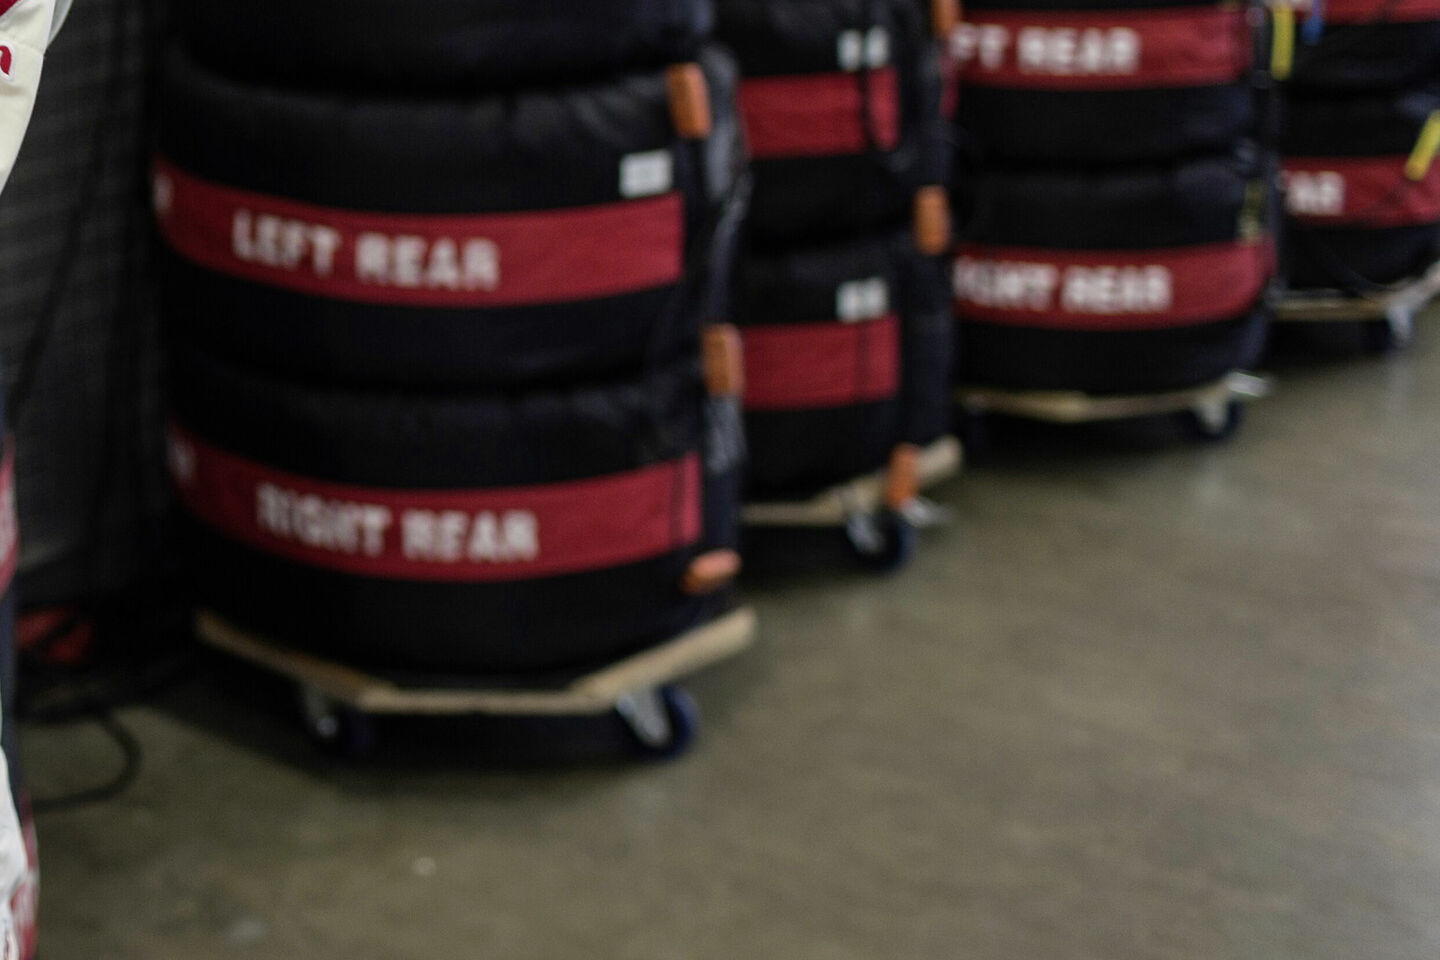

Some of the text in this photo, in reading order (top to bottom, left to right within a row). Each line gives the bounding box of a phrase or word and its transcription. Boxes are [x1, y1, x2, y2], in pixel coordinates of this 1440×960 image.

[1016, 26, 1141, 76] REAR
[232, 209, 500, 292] LEFT REAR
[1061, 264, 1173, 315] REAR
[256, 482, 540, 563] RIGHT REAR
